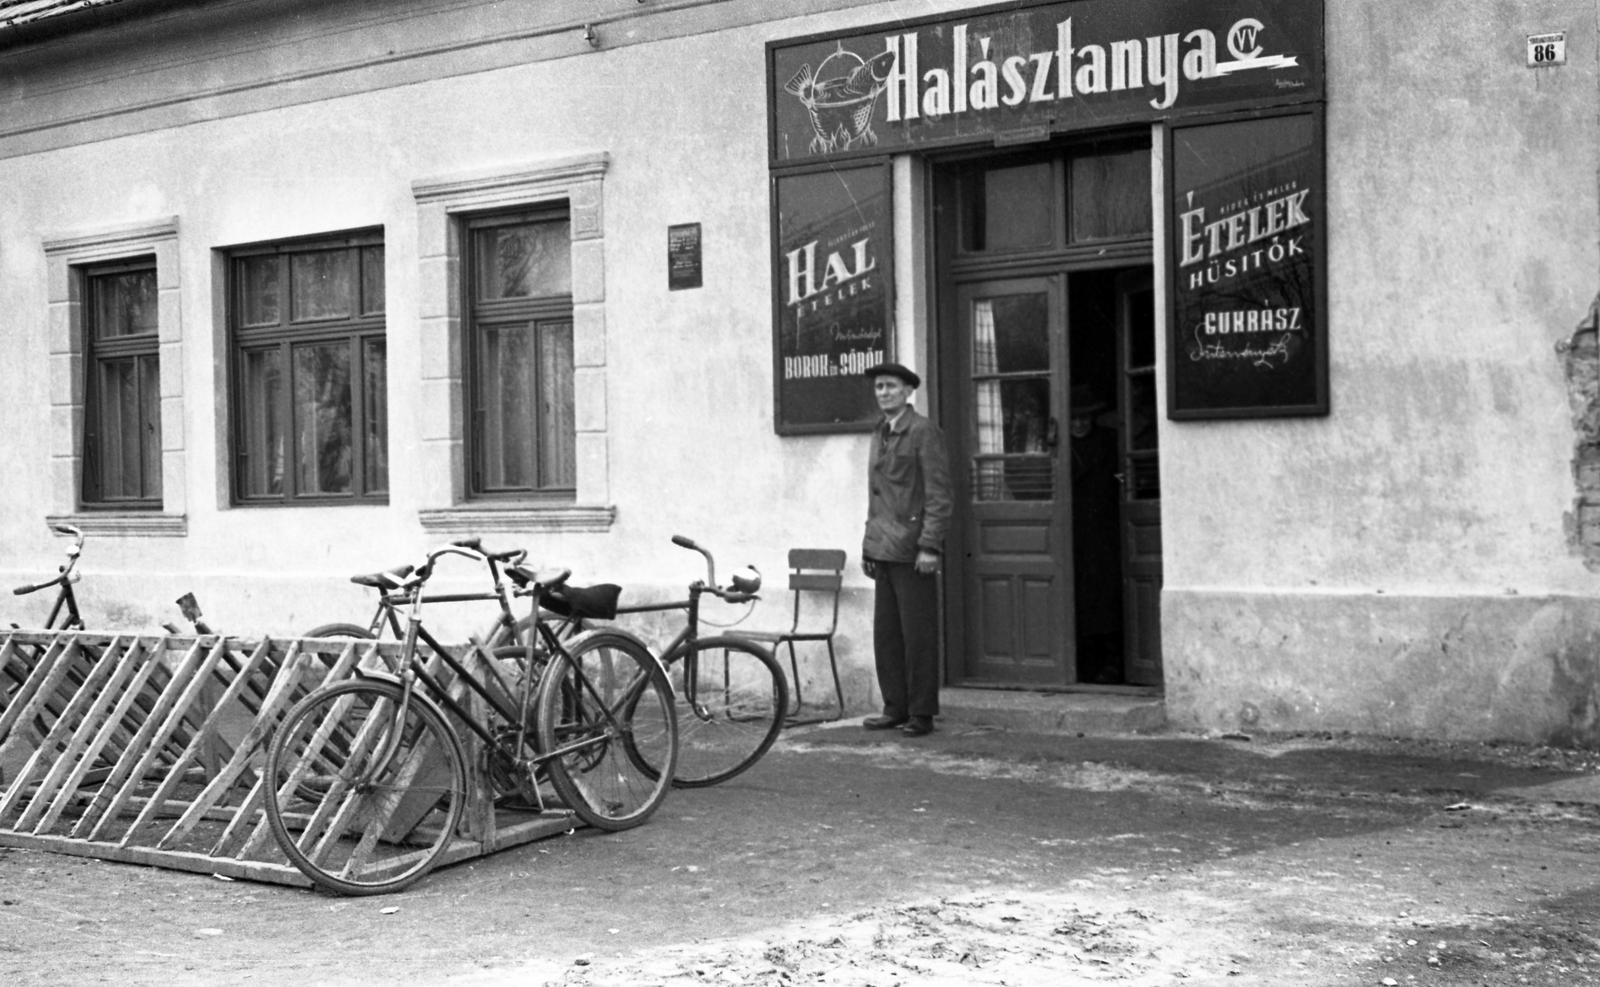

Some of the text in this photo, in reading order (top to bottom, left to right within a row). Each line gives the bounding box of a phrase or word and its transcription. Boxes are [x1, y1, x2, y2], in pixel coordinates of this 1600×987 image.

[885, 16, 1217, 122] Halásztanya
[1534, 43, 1556, 62] 86
[1179, 188, 1310, 268] ÉTELEK
[785, 237, 876, 307] HAL
[797, 276, 872, 318] ÉTELEK
[1204, 298, 1301, 335] CUKRÁSZ
[784, 353, 829, 379] BOROK
